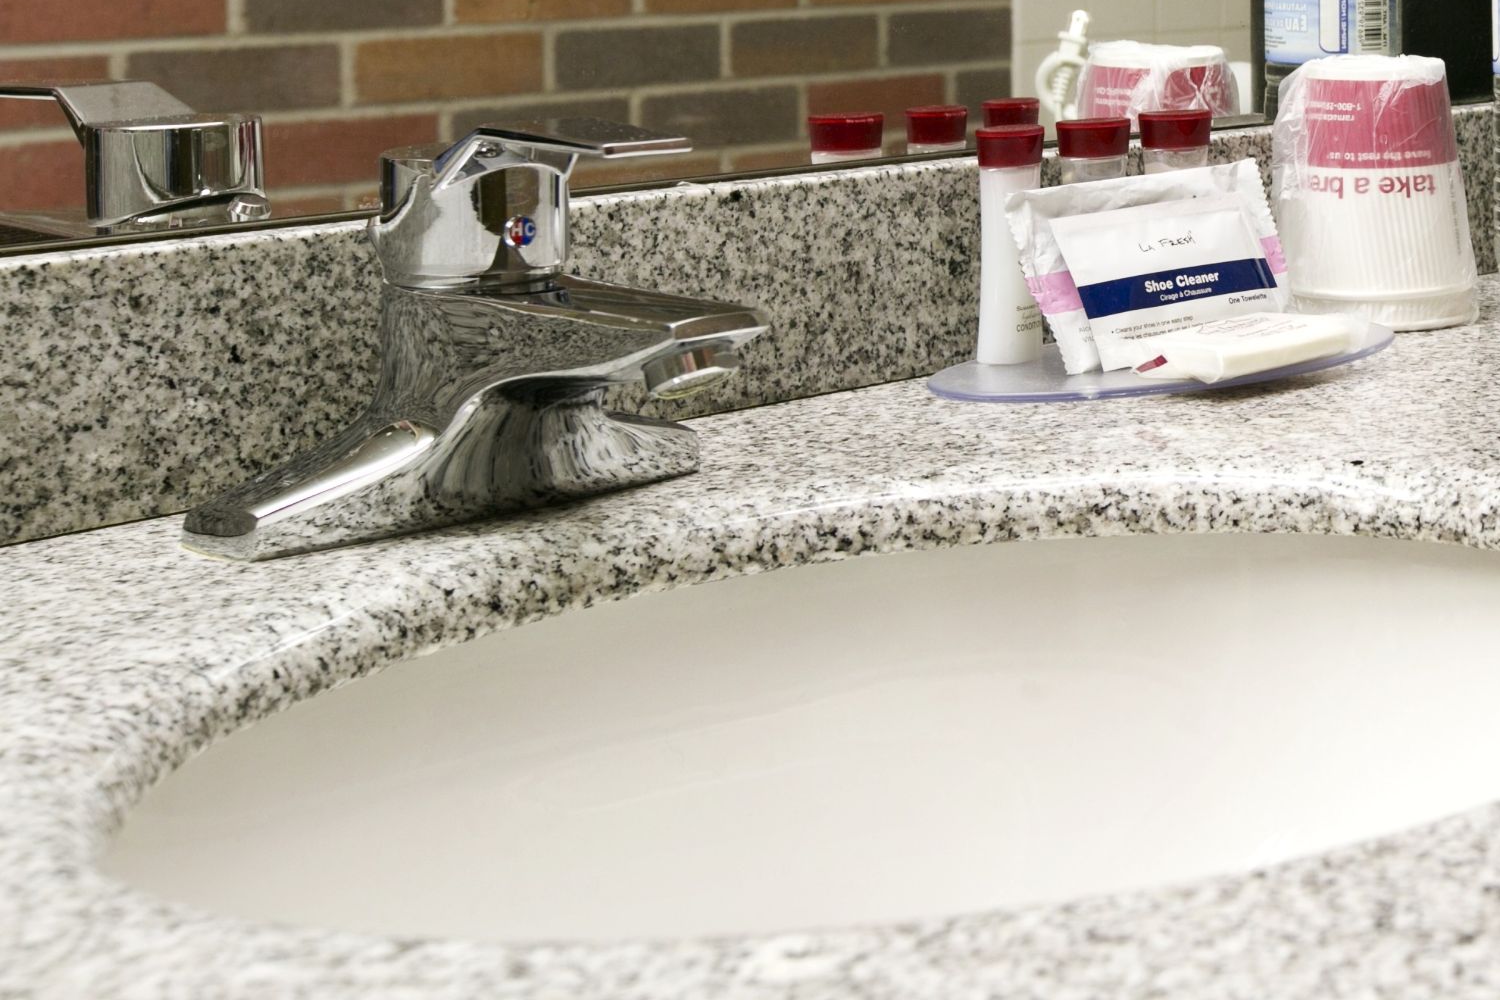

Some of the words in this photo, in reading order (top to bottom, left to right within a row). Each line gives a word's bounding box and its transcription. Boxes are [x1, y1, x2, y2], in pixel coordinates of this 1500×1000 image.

[1344, 153, 1355, 161] to
[1358, 152, 1380, 162] rest
[1383, 151, 1402, 161] the
[1404, 150, 1432, 159] leave
[1354, 176, 1370, 194] a
[1378, 174, 1436, 198] take
[1159, 233, 1195, 248] FRESH
[1144, 279, 1173, 293] Shoe
[1175, 272, 1220, 288] Cleaner
[1160, 292, 1179, 302] Cirage
[1184, 287, 1212, 297] Chaussure
[1228, 297, 1240, 305] One
[1241, 293, 1267, 302] Towelette
